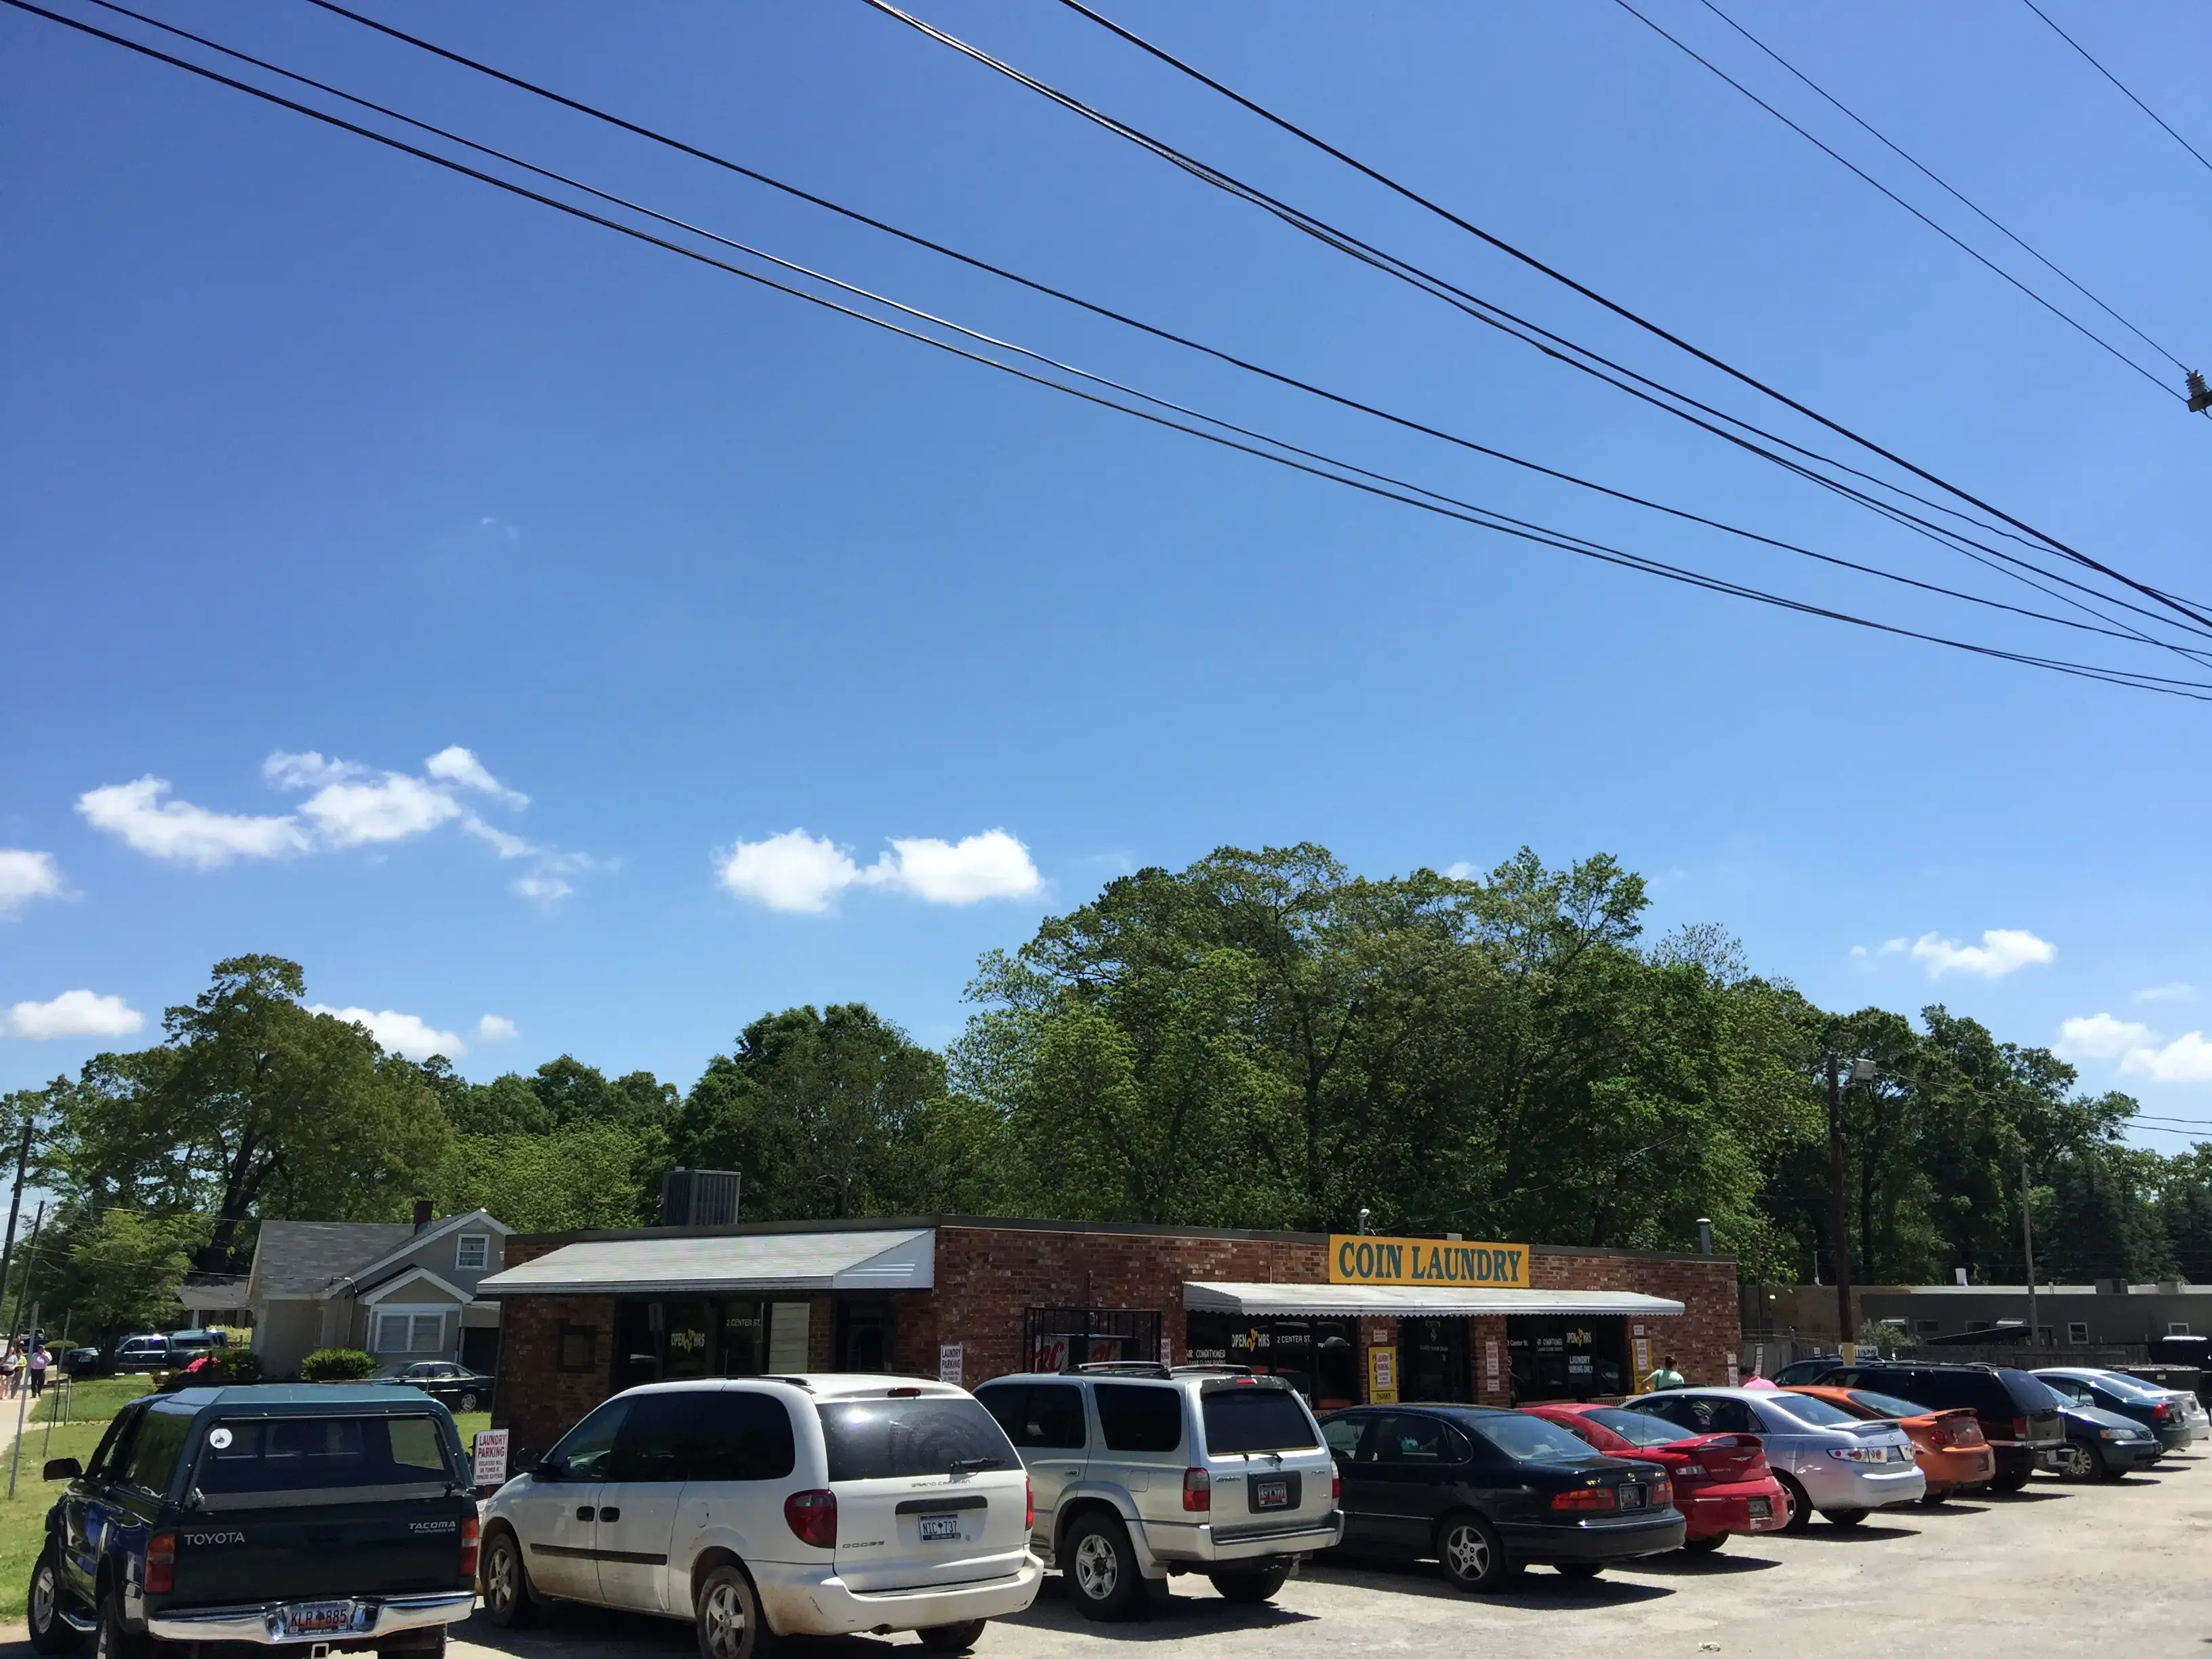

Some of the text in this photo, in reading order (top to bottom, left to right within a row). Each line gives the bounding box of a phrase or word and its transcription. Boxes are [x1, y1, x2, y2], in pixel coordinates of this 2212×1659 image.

[1338, 1242, 1522, 1282] COIN LAUNDRY
[726, 1319, 730, 1327] 2
[731, 1318, 752, 1327] CENTER
[670, 1332, 686, 1347] OPEN
[693, 1332, 705, 1347] HRS
[1231, 1334, 1247, 1348] OPEN
[1258, 1333, 1270, 1347] HRS
[1281, 1335, 1303, 1343] CENTER
[479, 1434, 507, 1446] LAUNDRY
[478, 1446, 505, 1458] PARKING
[408, 1521, 456, 1530] TACOMA
[922, 1520, 957, 1534] NIC 737
[184, 1532, 245, 1545] TOYOTA
[842, 1540, 885, 1549] DODGE
[291, 1608, 348, 1626] KLR 885
